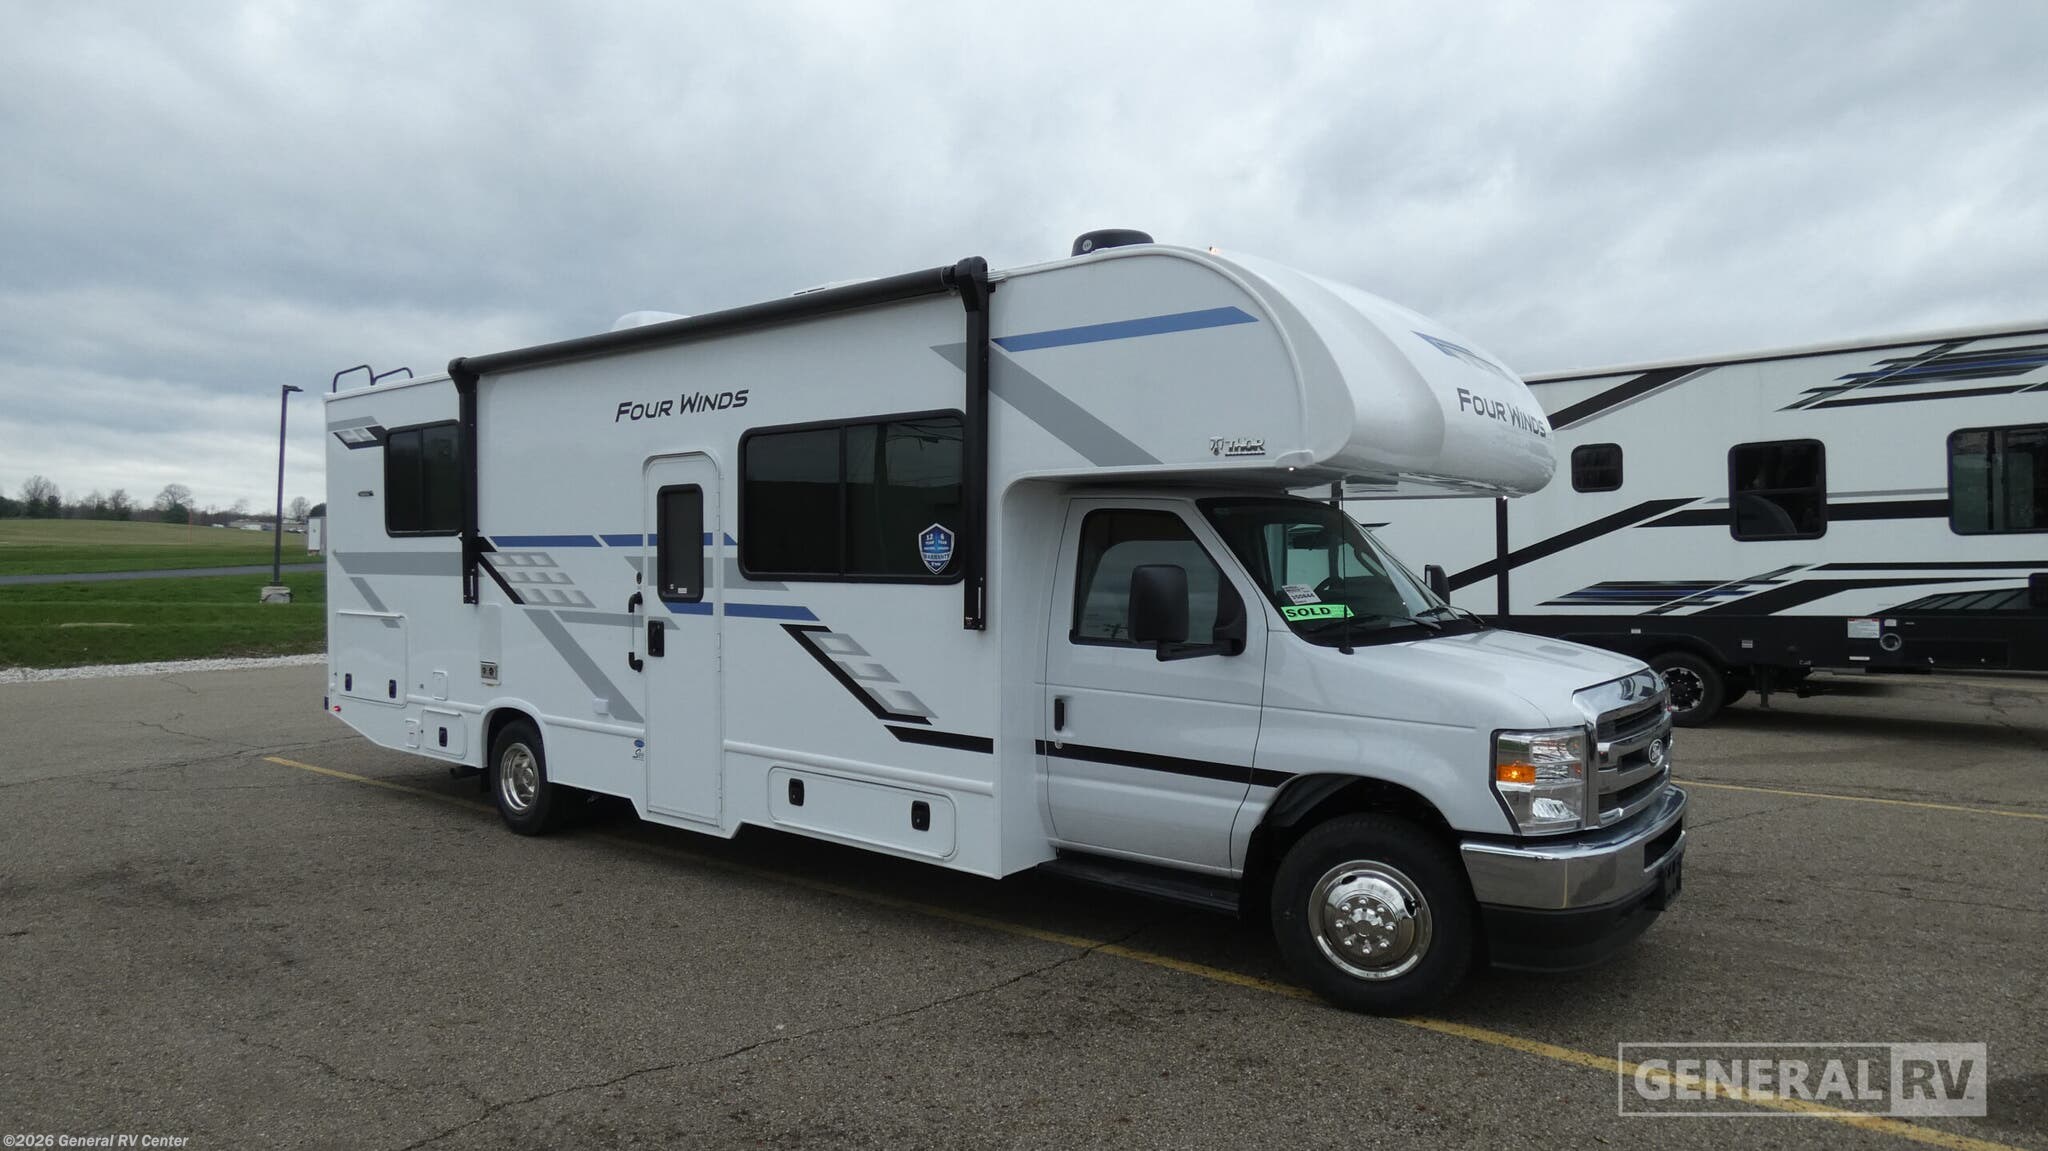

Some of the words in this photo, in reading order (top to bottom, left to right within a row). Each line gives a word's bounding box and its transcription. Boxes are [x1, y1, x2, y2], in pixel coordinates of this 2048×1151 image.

[615, 400, 674, 423] FOUR
[680, 389, 750, 415] WINDS
[1456, 387, 1508, 423] FOUR
[1507, 402, 1547, 439] WINDS
[1286, 606, 1332, 618] SOLD
